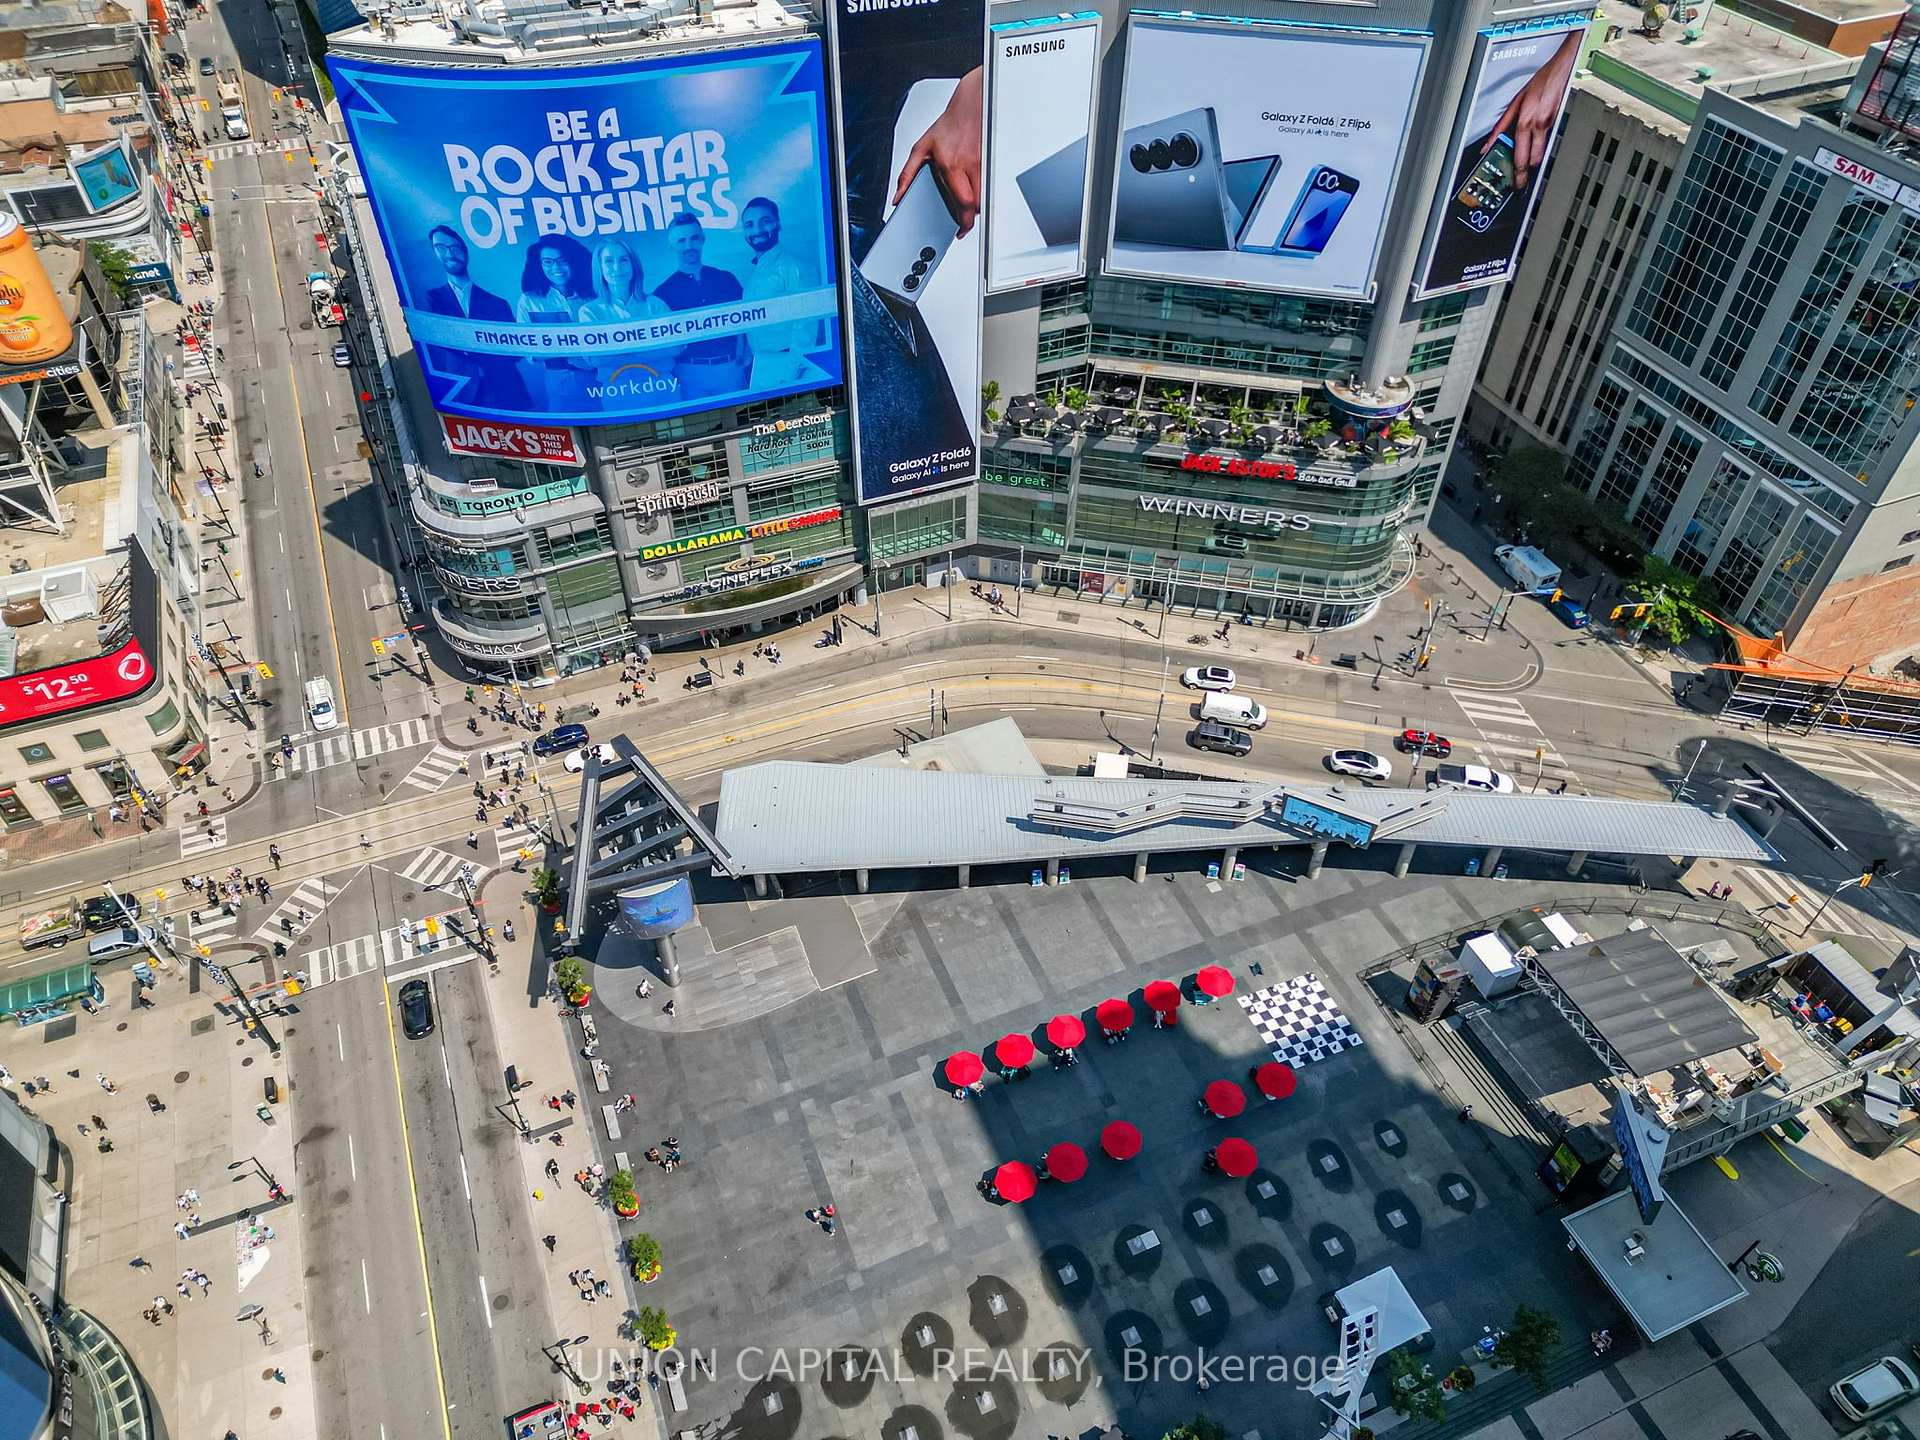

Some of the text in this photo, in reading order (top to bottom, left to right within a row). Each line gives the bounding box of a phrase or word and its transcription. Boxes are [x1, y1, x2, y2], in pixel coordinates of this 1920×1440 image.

[1006, 39, 1066, 57] SAMSUNG
[1492, 45, 1537, 61] SAMSUNG
[546, 107, 621, 142] BE A
[1261, 111, 1371, 131] Galaxy Z Fold6 Z Flip6
[1278, 125, 1305, 135] Galaxy
[1330, 130, 1350, 138] here
[443, 129, 730, 196] ROCK STAR
[1834, 157, 1876, 185] SAM
[460, 177, 738, 249] OF BUSINESS
[475, 307, 767, 347] FINANCE & HR ON ONE EPIC PLATFORM
[586, 376, 680, 399] workday
[753, 424, 776, 437] The
[803, 412, 832, 427] Store
[453, 424, 542, 455] JACK'S
[540, 432, 566, 442] PARTY
[543, 441, 562, 449] THIS
[800, 429, 833, 442] COMING
[806, 439, 831, 450] SOON
[544, 448, 562, 457] WAY
[747, 440, 770, 454] Hard
[889, 446, 971, 473] Galaxy Z Fold6
[891, 461, 970, 484] Galaxy AI is here
[985, 469, 1050, 488] be great.
[463, 491, 535, 511] TORONTO
[1139, 495, 1312, 531] WINNERS
[643, 529, 744, 560] DOLLARAMA
[711, 561, 793, 589] CINEPLEX
[474, 641, 526, 656] SHACK
